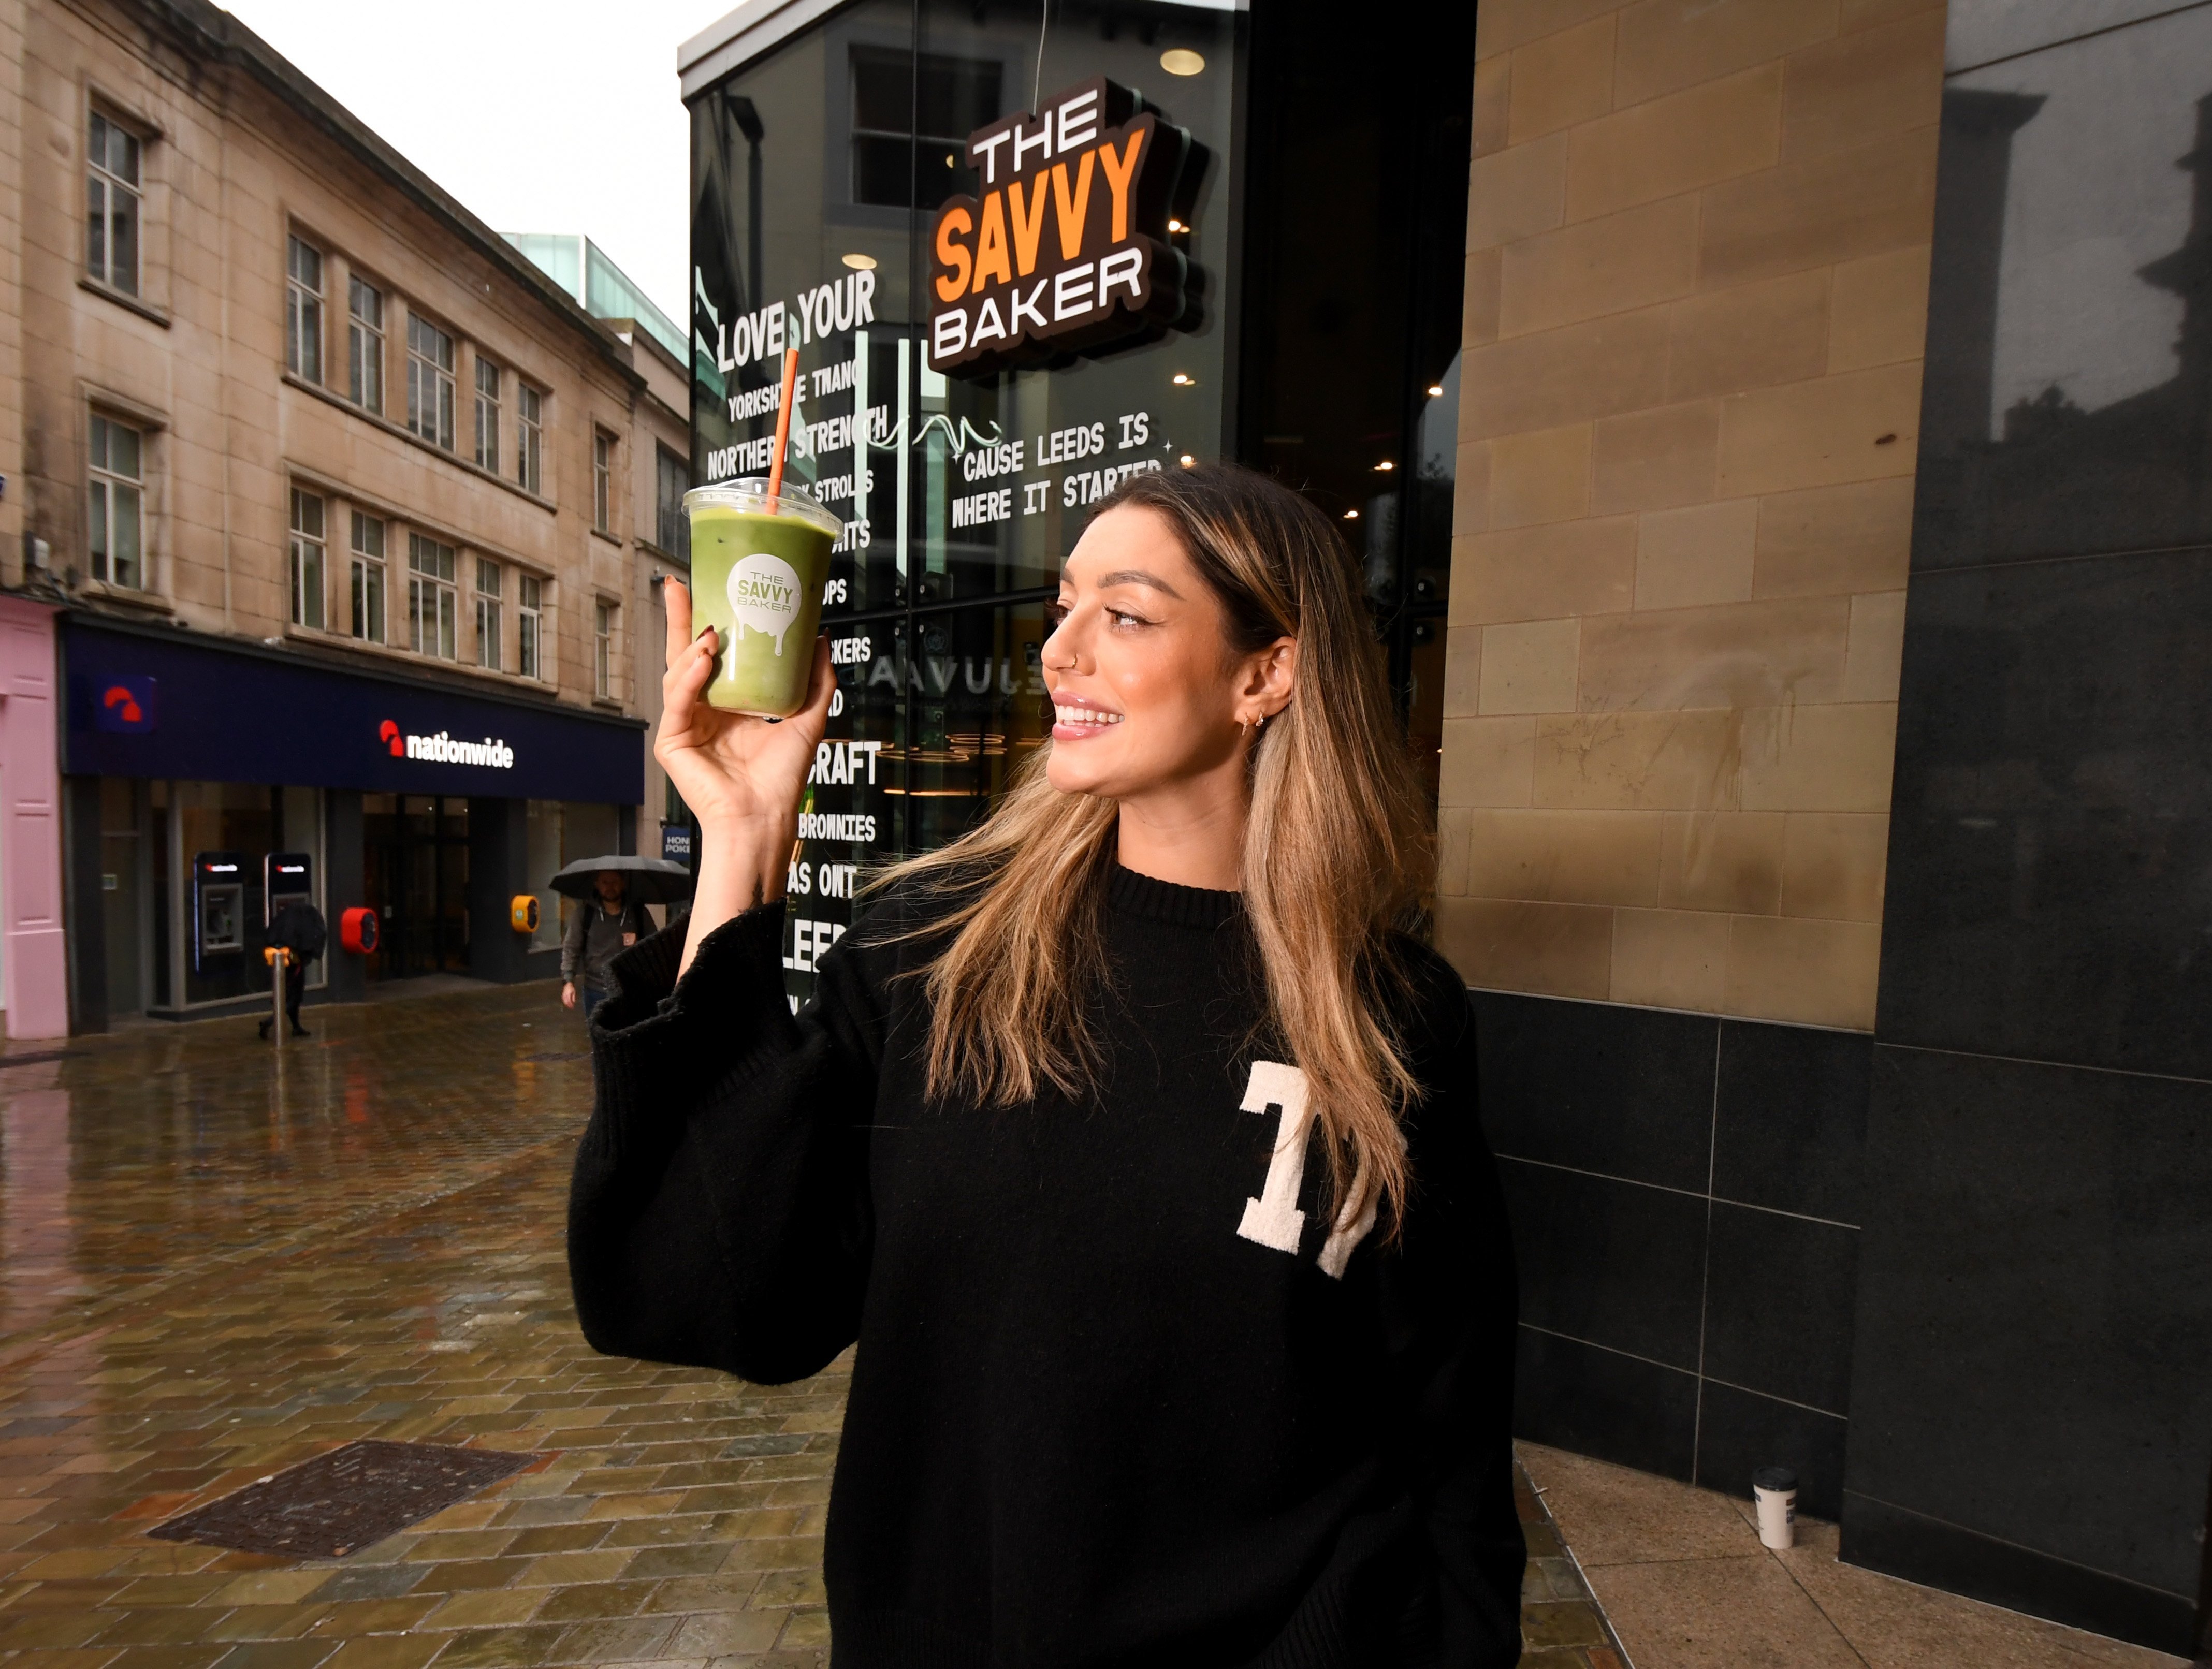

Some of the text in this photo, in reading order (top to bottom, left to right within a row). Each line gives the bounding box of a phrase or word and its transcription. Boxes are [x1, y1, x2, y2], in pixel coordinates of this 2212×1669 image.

[973, 89, 1098, 184] THE
[936, 128, 1145, 302] SAVVY
[717, 270, 875, 373] LOVE YOUR
[934, 247, 1142, 359] BAKER
[728, 375, 806, 423] YORKSHE
[795, 404, 887, 459] STRENGTH
[963, 412, 1149, 482] CAUSE LEEDS IS
[952, 488, 1011, 529] WHERE
[1023, 480, 1051, 515] IT
[738, 579, 793, 604] SAVVY
[750, 571, 784, 585] THE
[737, 597, 792, 614] BAKER
[831, 636, 871, 664] KERS
[406, 730, 514, 769] nationwide
[807, 741, 881, 785] RAFT
[666, 836, 690, 845] HON
[798, 813, 876, 842] BROWNIES
[787, 861, 811, 895] AS
